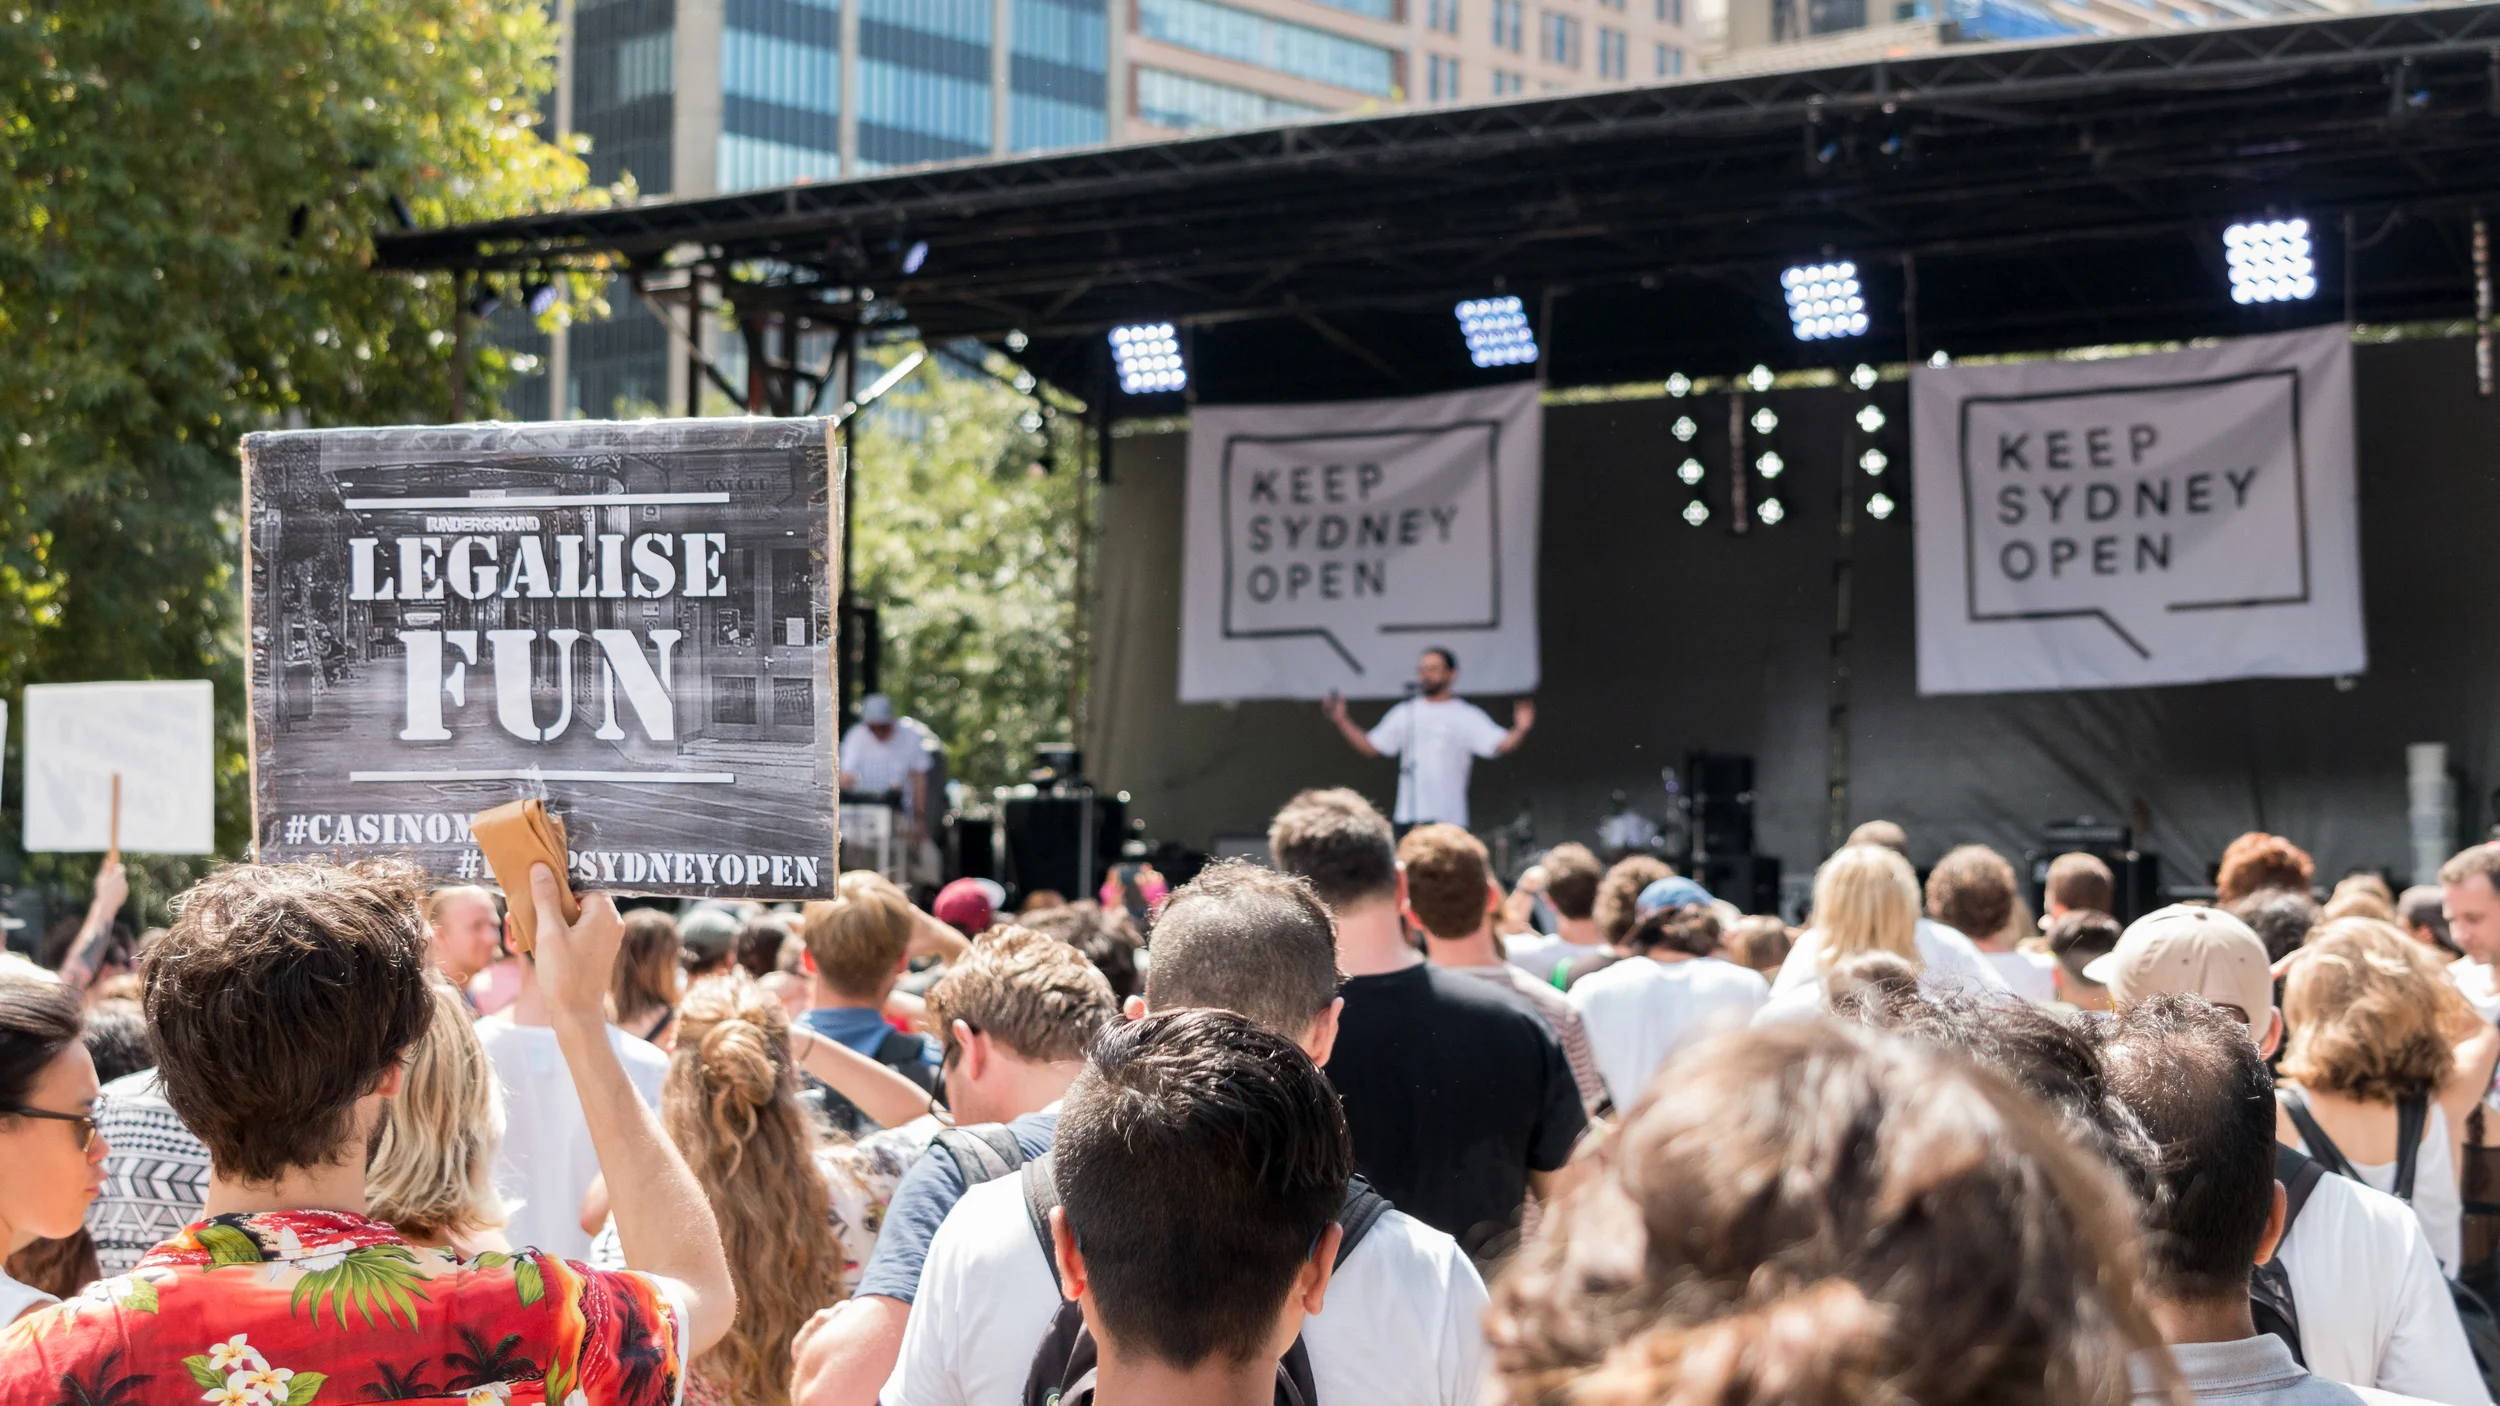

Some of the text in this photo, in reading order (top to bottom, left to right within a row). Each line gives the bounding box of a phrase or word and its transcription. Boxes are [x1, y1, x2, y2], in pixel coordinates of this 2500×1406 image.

[1998, 424, 2159, 471] KEEP
[1250, 463, 1384, 505] KEEP
[1997, 466, 2257, 526] SYDNEY
[1248, 504, 1458, 553] SYDNEY
[348, 532, 727, 600] LEGALISE
[1246, 558, 1387, 603] OPEN
[2000, 532, 2172, 581] OPEN
[398, 629, 682, 742] FUN
